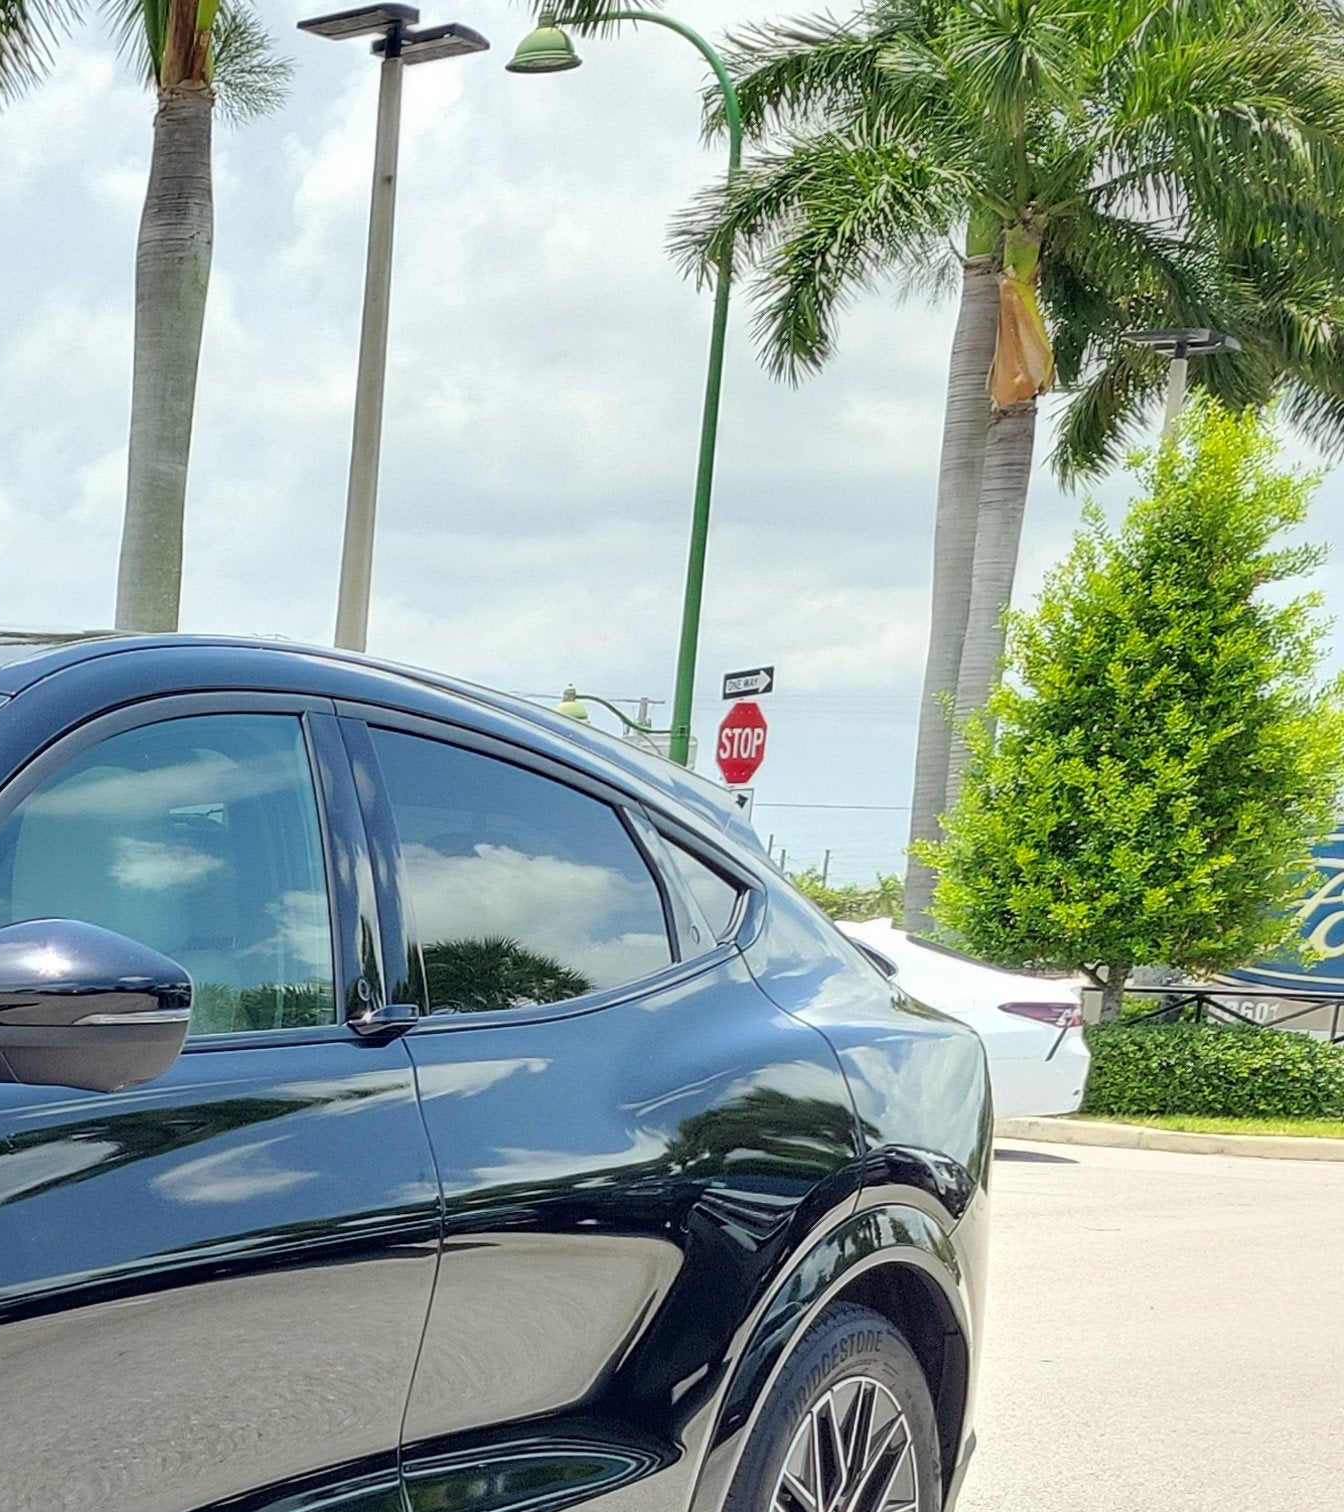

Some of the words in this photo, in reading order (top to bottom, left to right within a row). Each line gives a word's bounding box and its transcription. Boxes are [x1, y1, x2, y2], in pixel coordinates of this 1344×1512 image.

[728, 679, 742, 691] ONE
[743, 677, 759, 689] WAY
[719, 727, 765, 759] STOP
